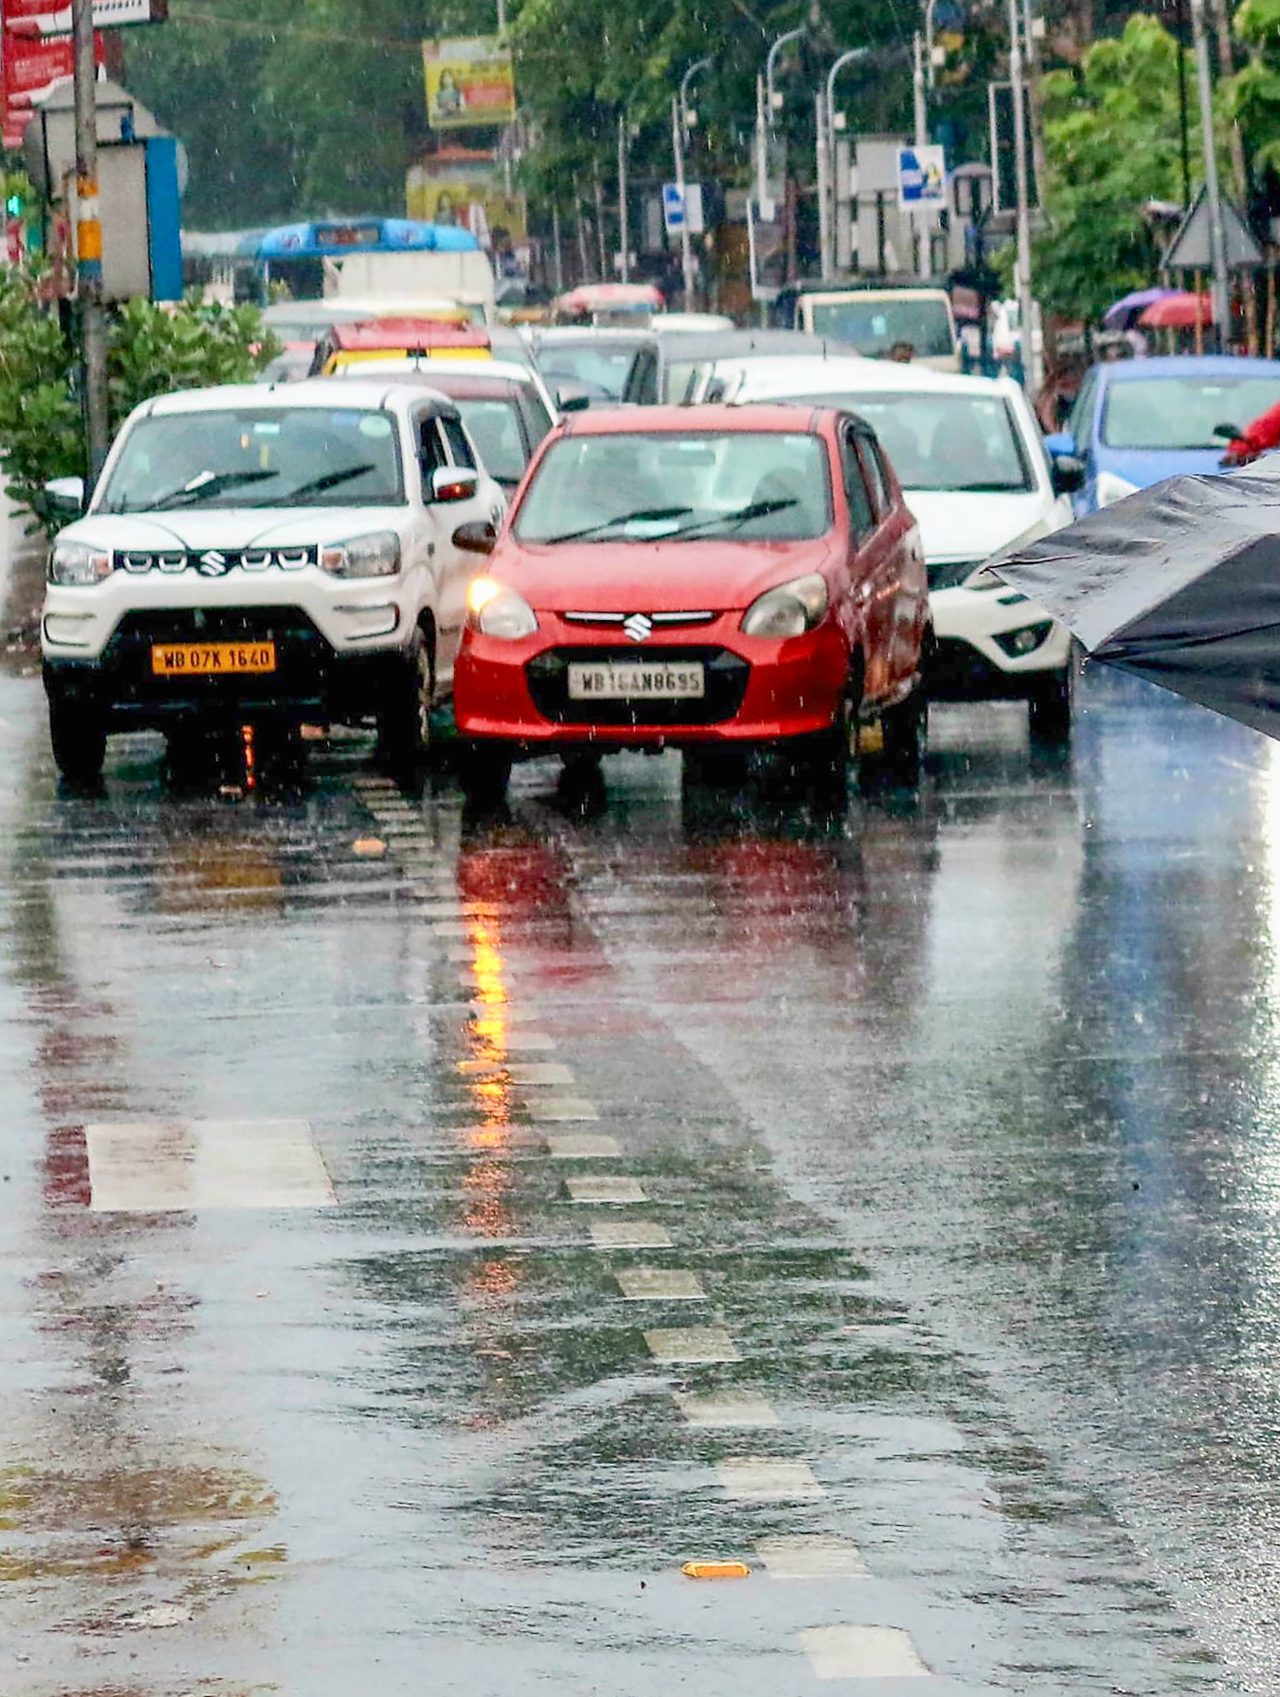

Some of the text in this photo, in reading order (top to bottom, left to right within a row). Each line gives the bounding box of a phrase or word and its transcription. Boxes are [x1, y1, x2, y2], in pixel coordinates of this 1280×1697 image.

[164, 648, 270, 668] WB 07K 1640
